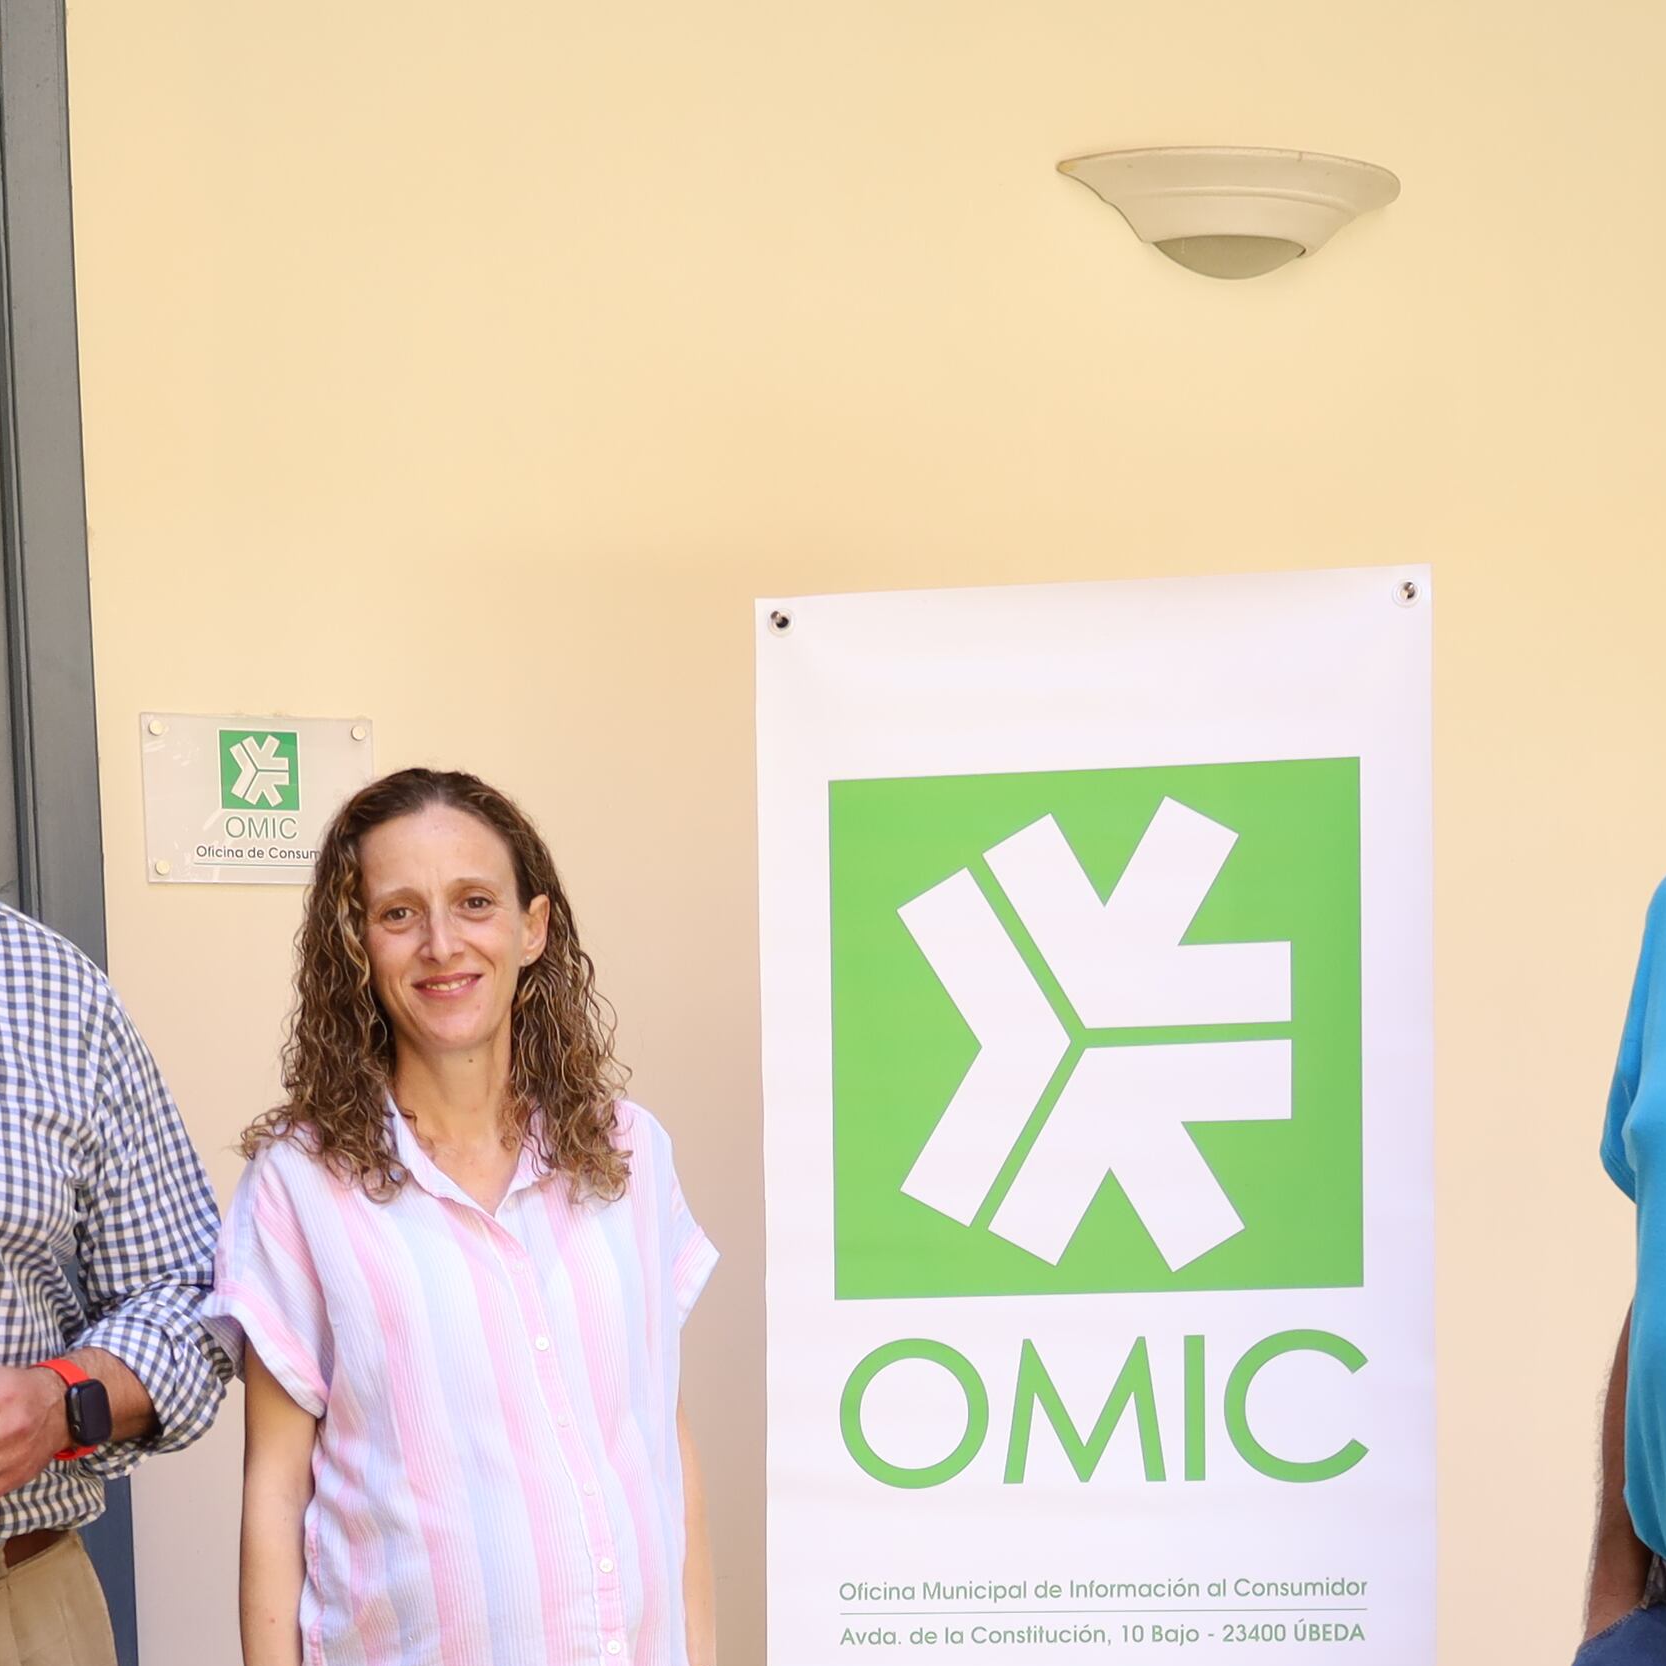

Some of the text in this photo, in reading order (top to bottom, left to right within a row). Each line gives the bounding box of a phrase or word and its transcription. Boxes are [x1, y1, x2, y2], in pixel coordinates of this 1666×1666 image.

[225, 816, 298, 839] OMIC
[196, 845, 321, 860] Oficina de Consum
[839, 1328, 1370, 1490] OMIC
[839, 1576, 1368, 1604] Oficina Municipal de Información al Consumidor
[839, 1627, 902, 1646] Avda.
[909, 1627, 938, 1645] de
[945, 1626, 964, 1645] la
[970, 1623, 1113, 1647] Constitución,
[1122, 1624, 1144, 1643] 10
[1151, 1624, 1200, 1647] Bajo
[1222, 1623, 1287, 1643] 23400
[1293, 1618, 1366, 1642] ÚBEDA
